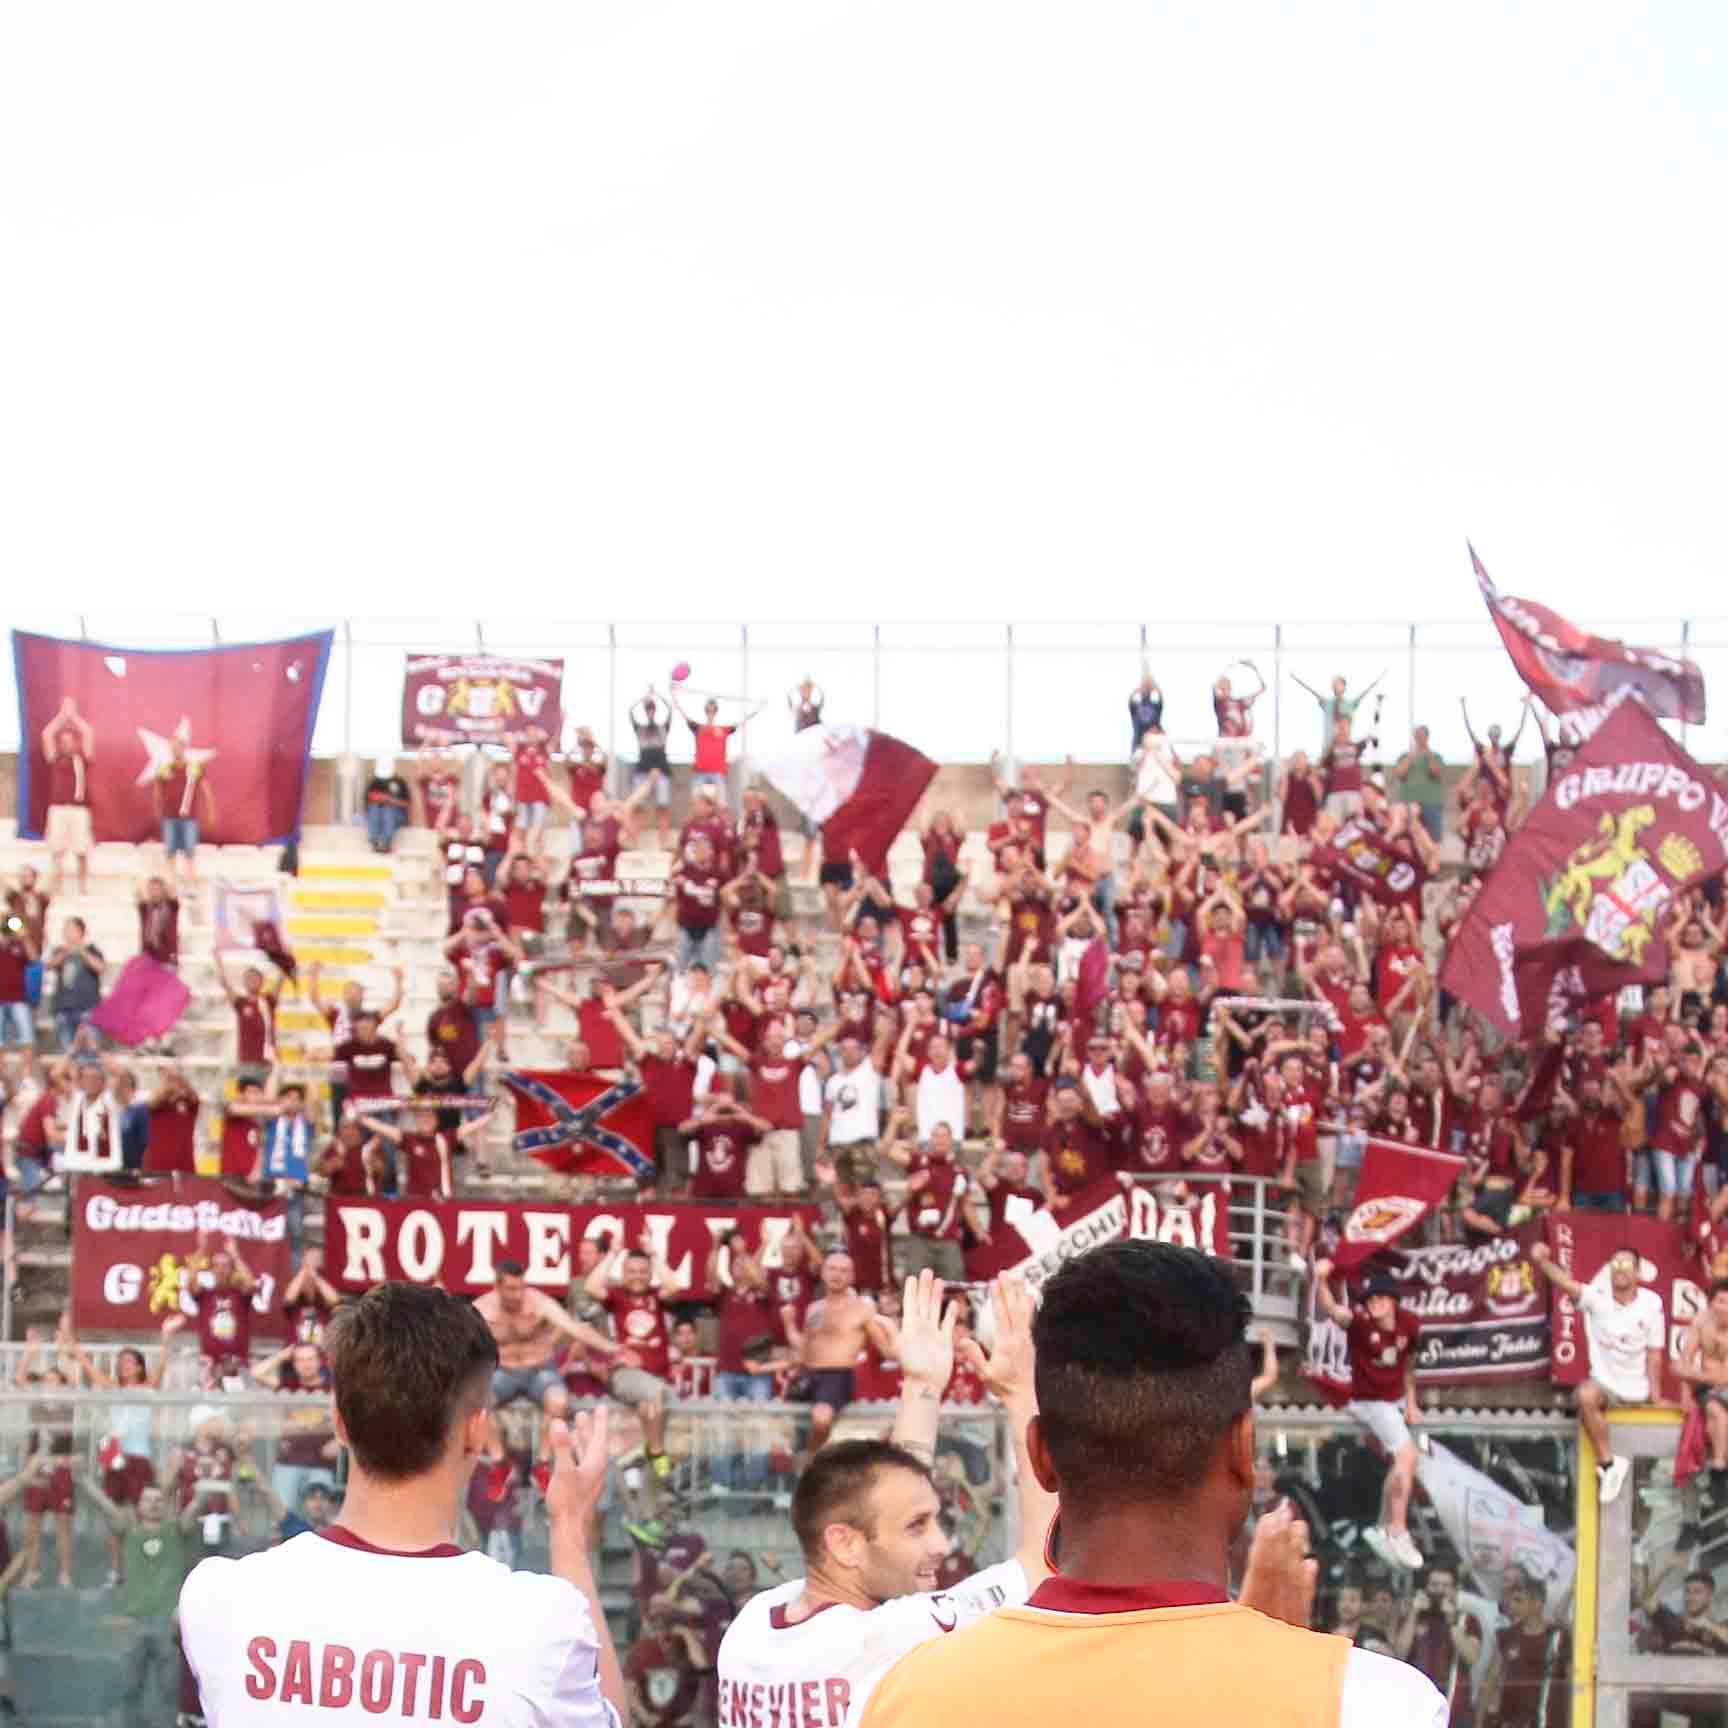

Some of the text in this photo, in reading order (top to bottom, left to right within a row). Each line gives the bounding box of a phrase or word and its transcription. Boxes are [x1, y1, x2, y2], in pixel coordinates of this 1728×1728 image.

[1556, 762, 1706, 812] GRUPPO
[245, 1636, 487, 1725] SABOTIC
[718, 1677, 852, 1728] ENEVIER
